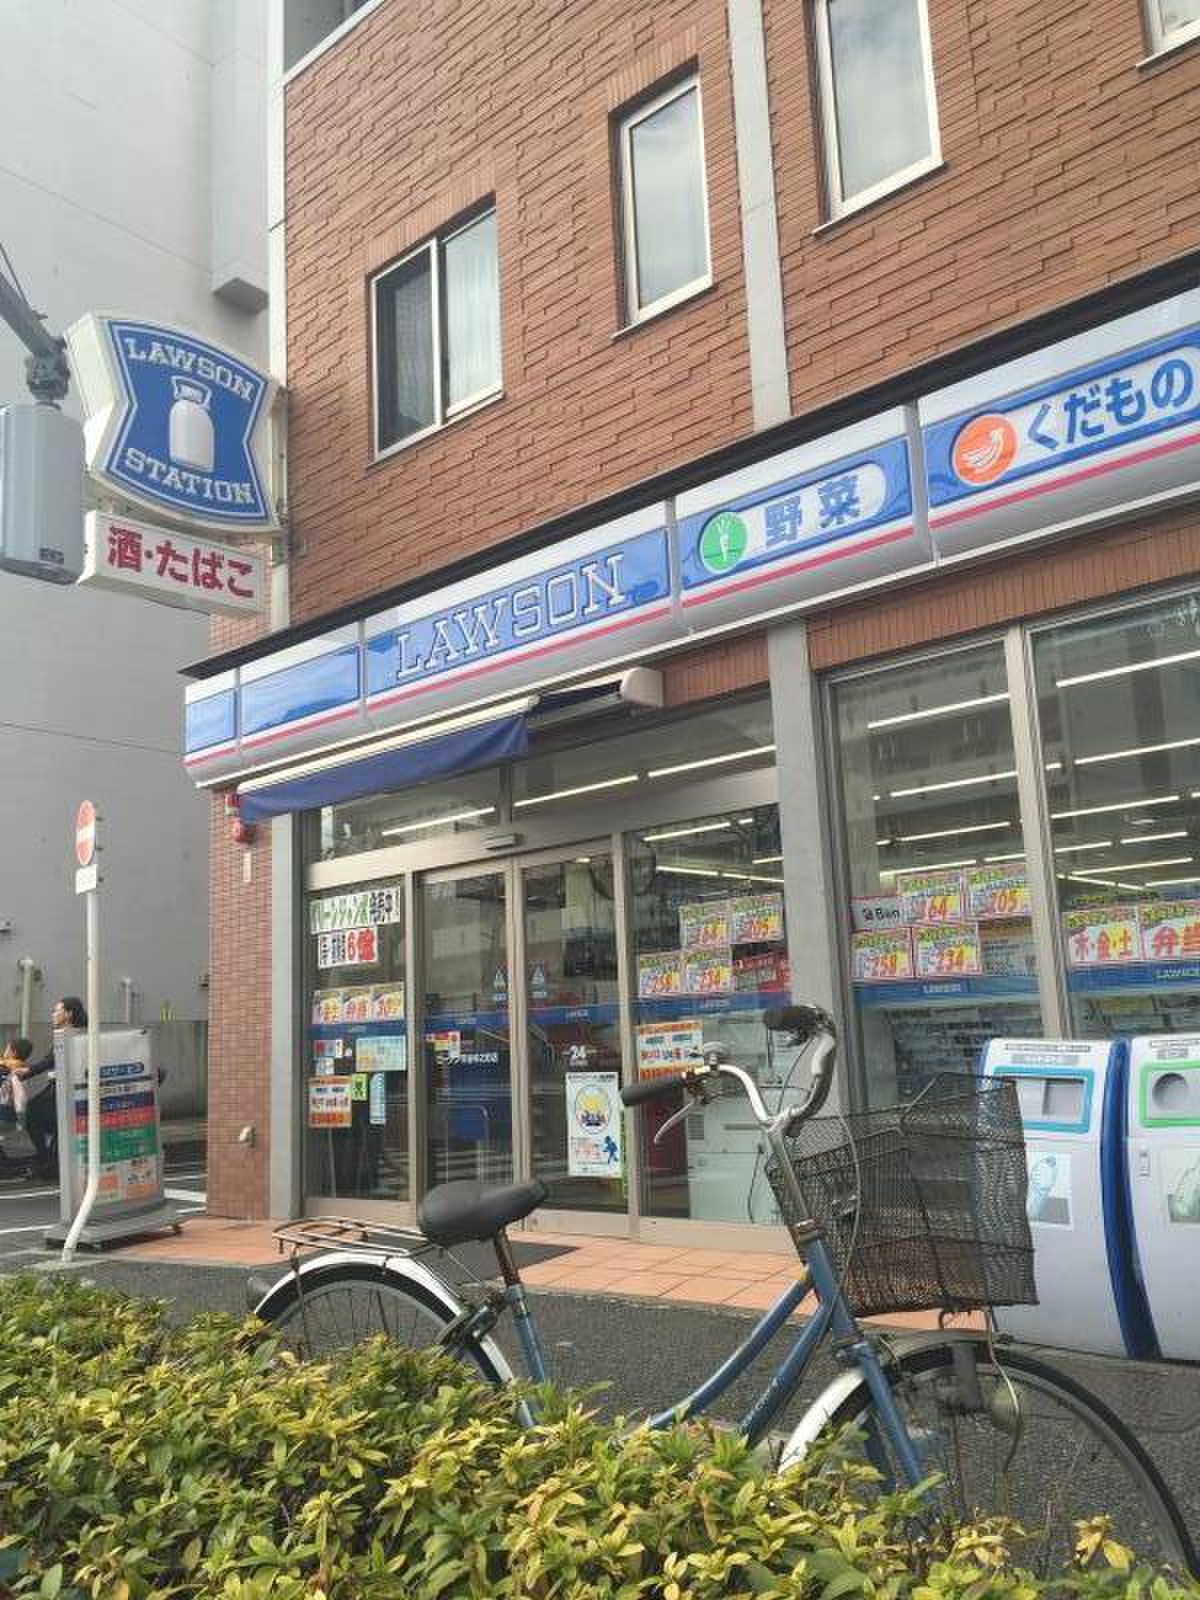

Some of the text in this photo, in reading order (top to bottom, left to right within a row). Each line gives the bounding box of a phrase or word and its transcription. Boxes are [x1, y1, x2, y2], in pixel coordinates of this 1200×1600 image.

[124, 337, 255, 401] LAWSON
[1027, 358, 1194, 450] くだもの
[124, 447, 256, 504] STATION
[765, 474, 862, 547] 野菜
[107, 525, 255, 598] 酒・たばこ
[396, 552, 626, 681] LAWSON
